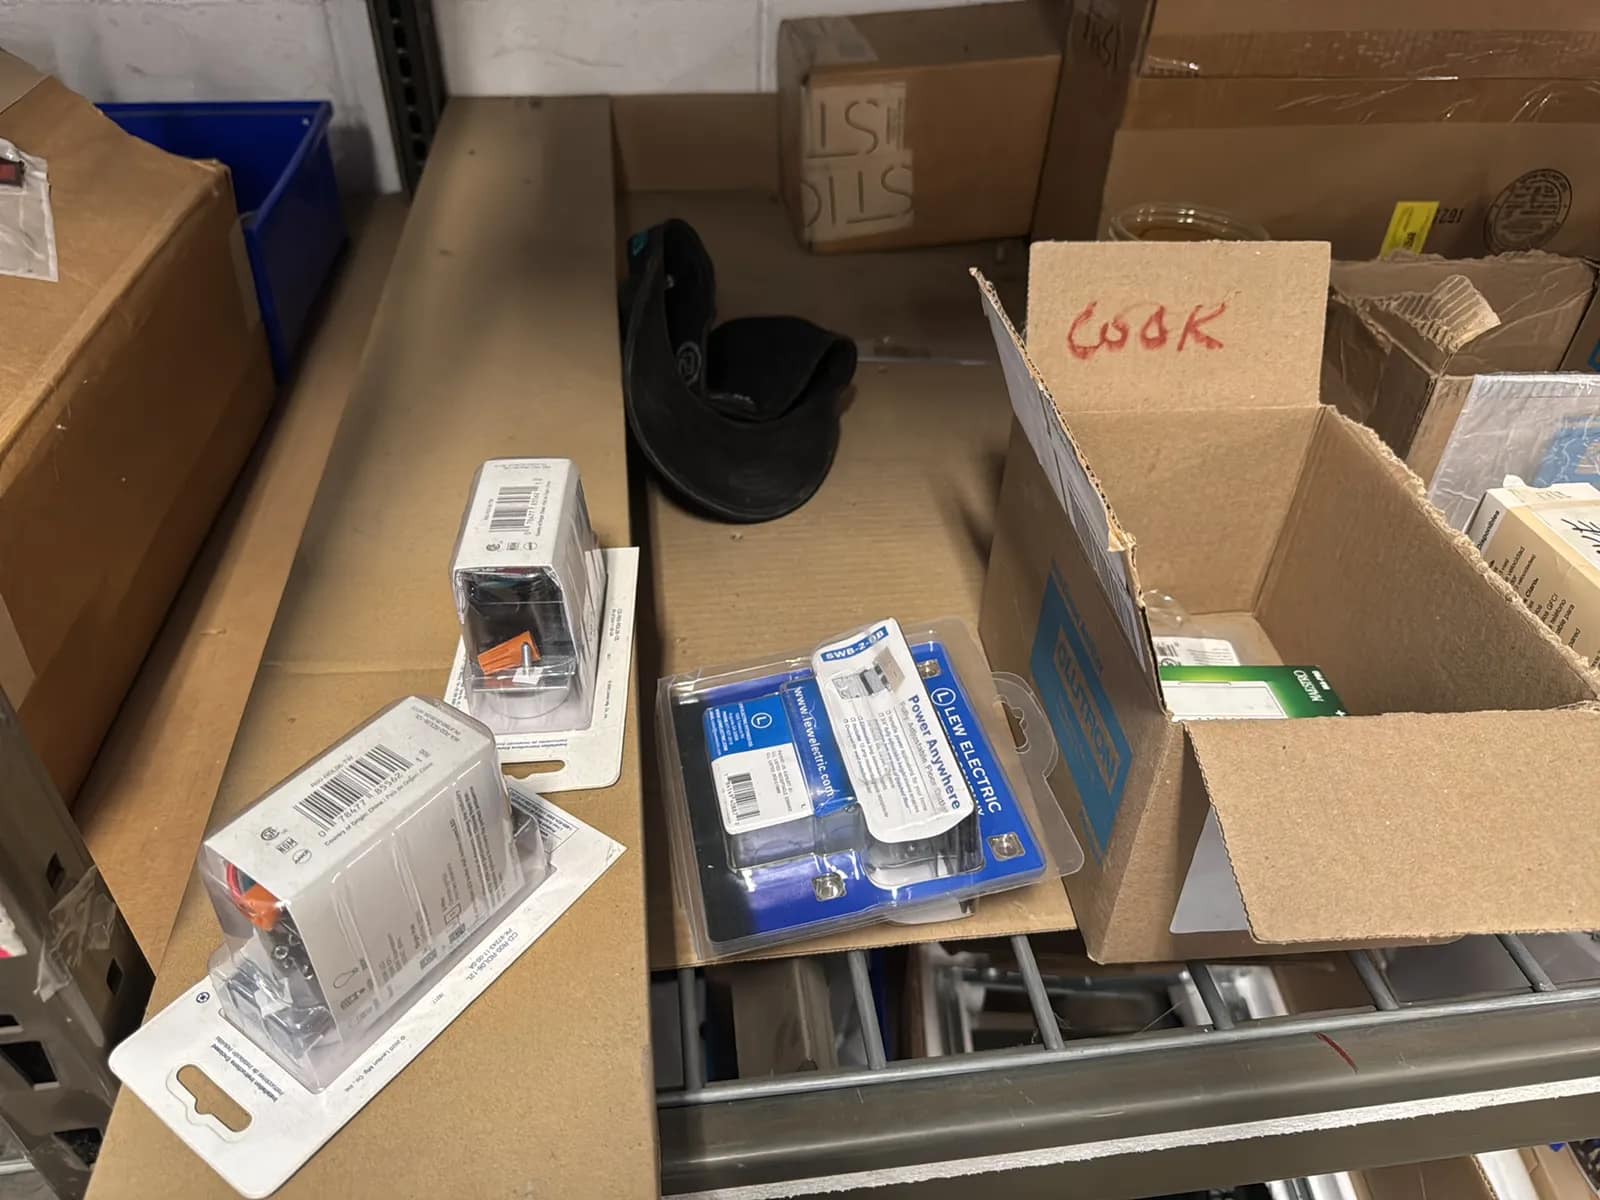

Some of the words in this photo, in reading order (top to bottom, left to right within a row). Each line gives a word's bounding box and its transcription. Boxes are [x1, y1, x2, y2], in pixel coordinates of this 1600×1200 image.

[1293, 670, 1323, 701] MAESTRO
[790, 686, 836, 797] www.lewelectric.com
[907, 694, 932, 737] Power
[924, 738, 962, 810] Anywhere
[943, 705, 966, 738] LEW
[958, 739, 1001, 814] ELECTRIC
